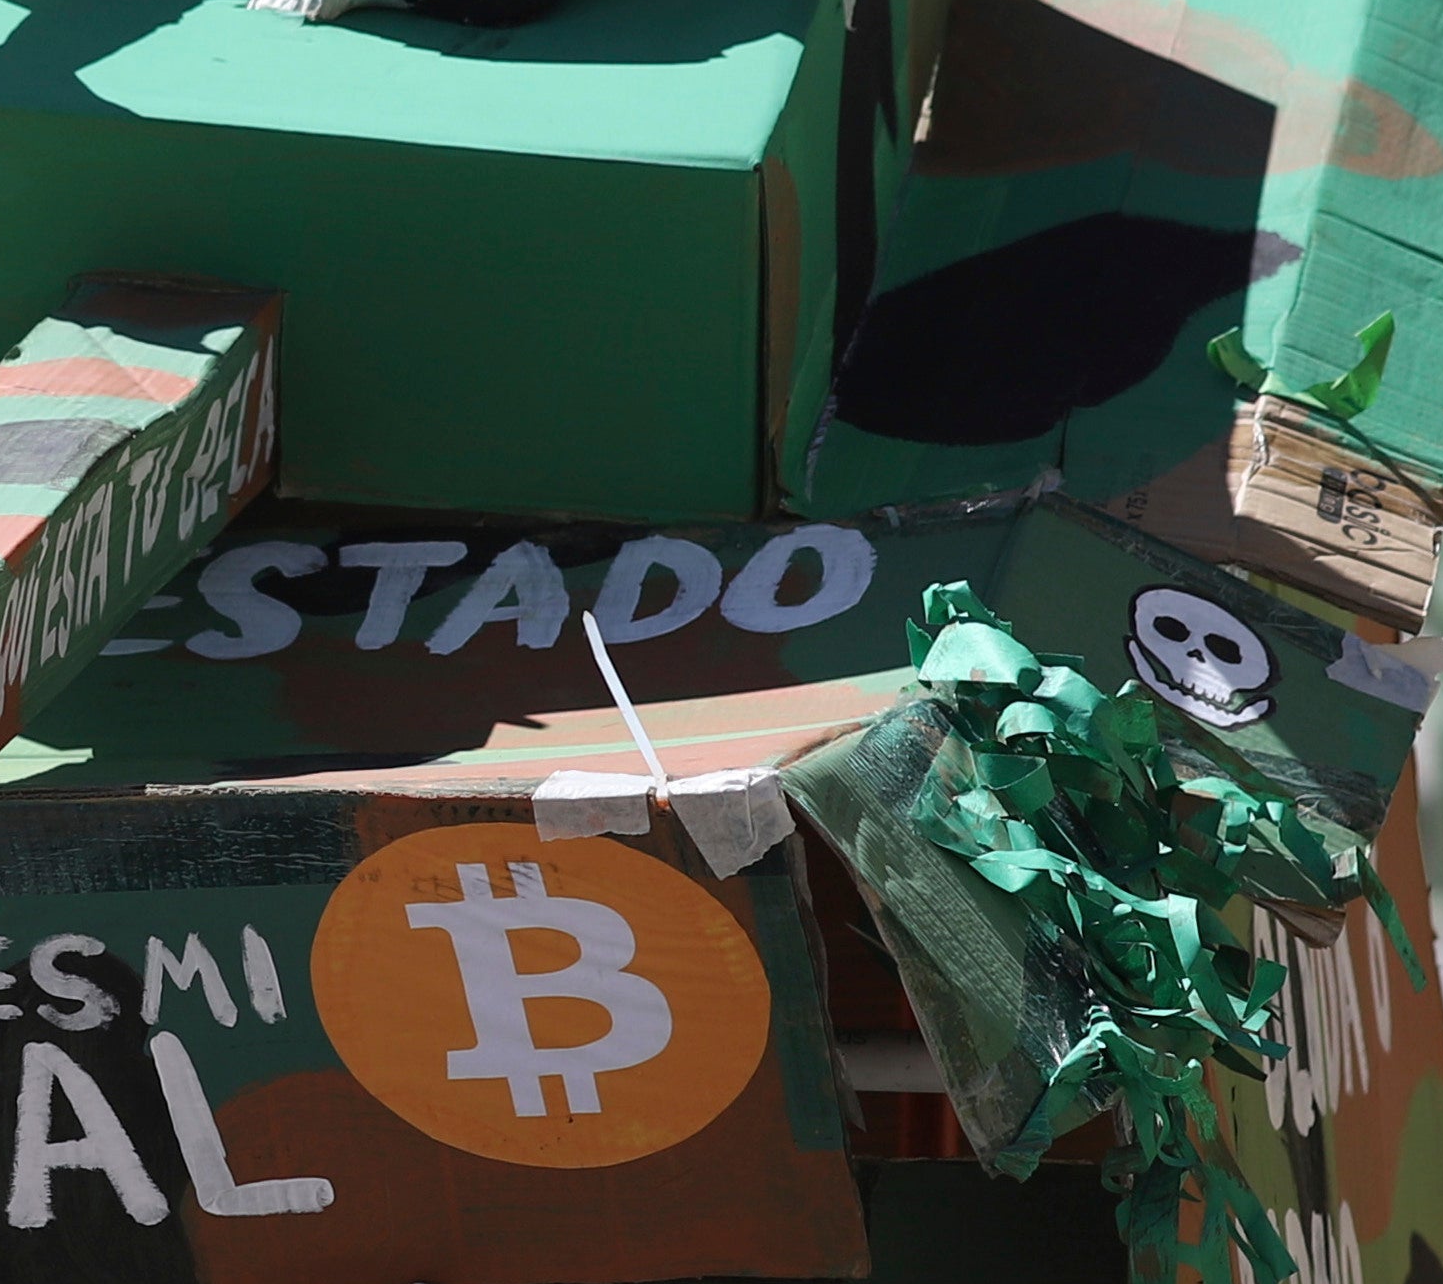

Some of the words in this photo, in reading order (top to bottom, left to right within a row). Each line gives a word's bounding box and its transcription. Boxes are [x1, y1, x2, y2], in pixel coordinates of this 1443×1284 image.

[123, 427, 189, 585] TU
[178, 334, 275, 541] BECA
[142, 923, 287, 1029] MI
